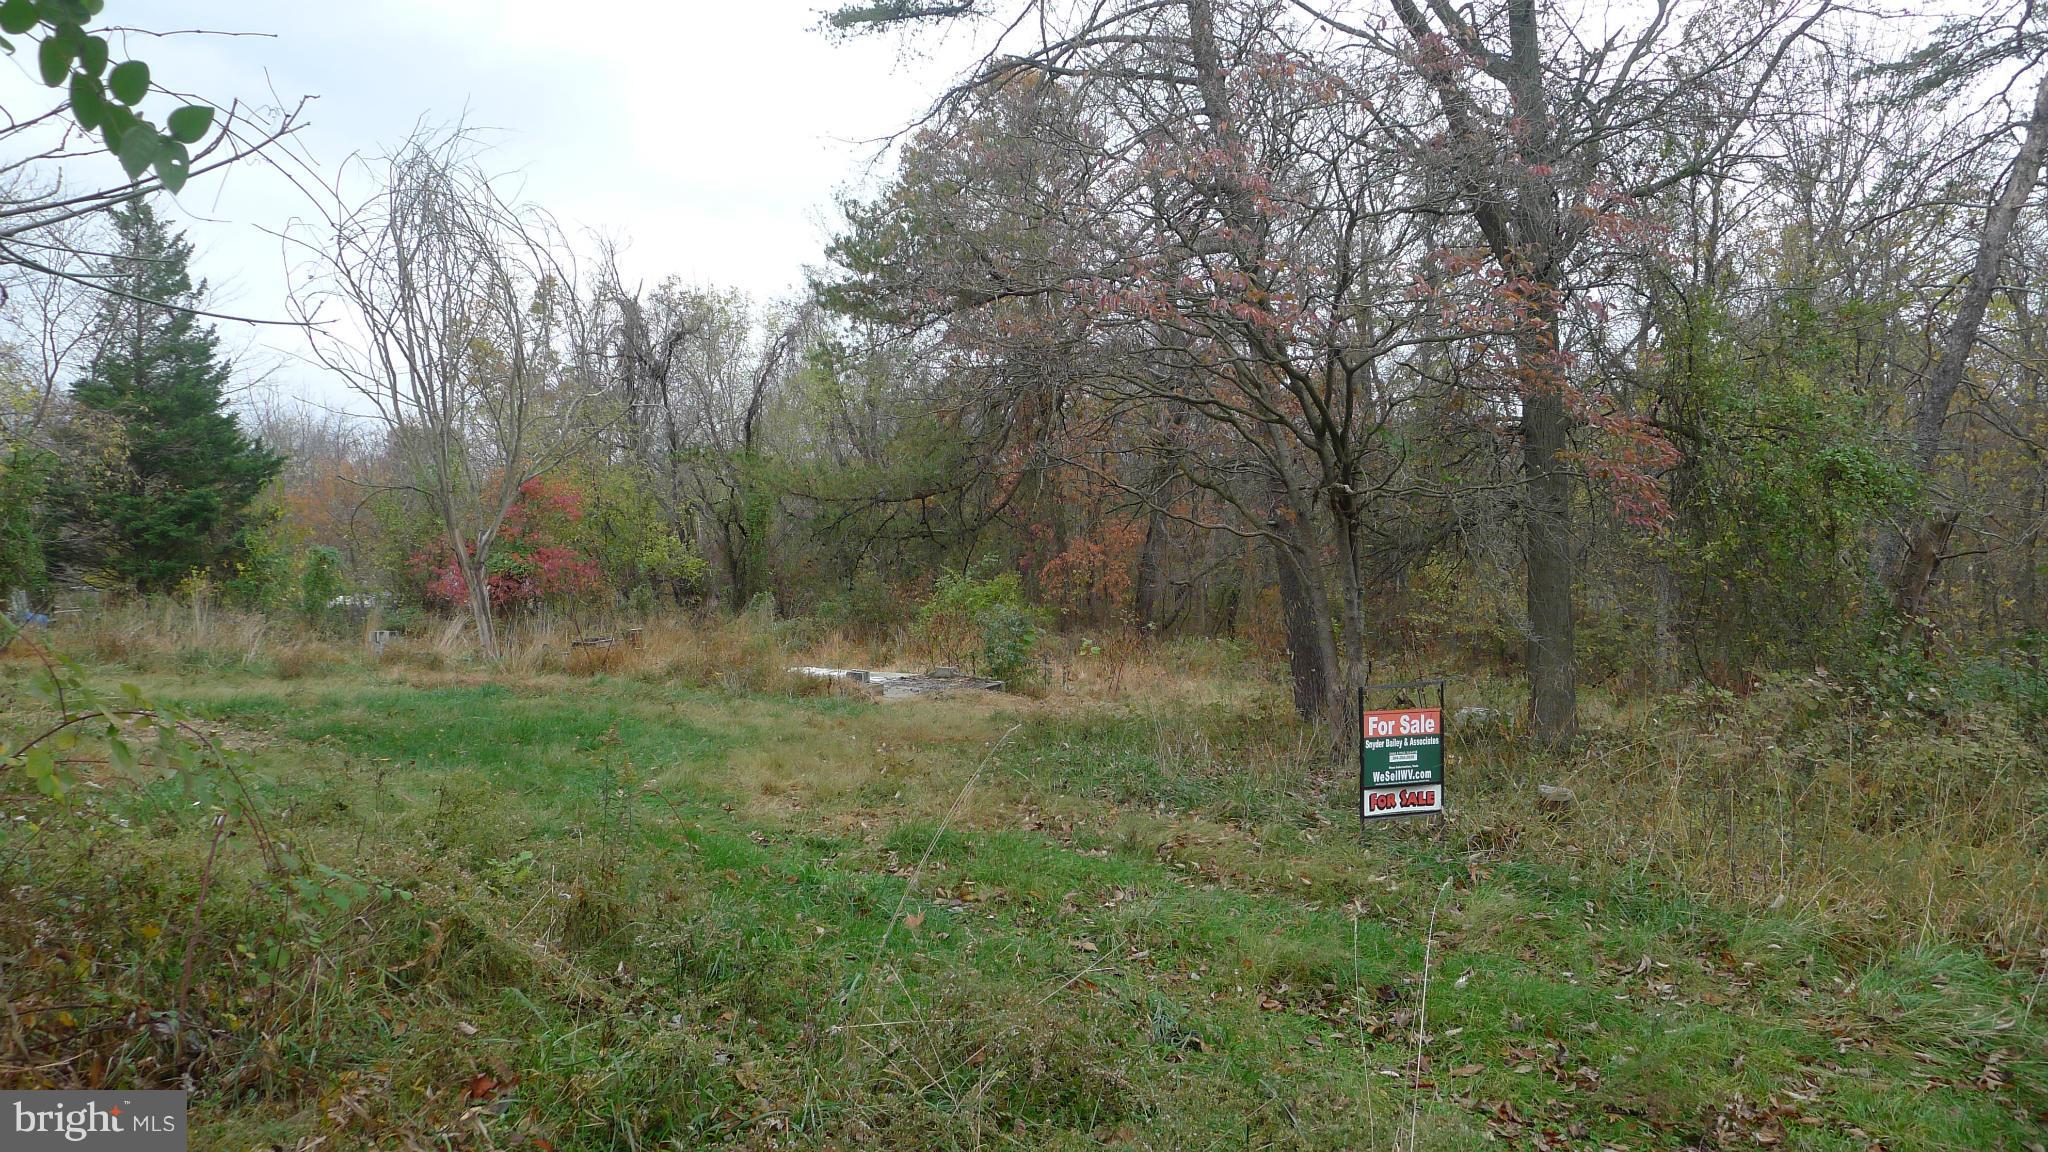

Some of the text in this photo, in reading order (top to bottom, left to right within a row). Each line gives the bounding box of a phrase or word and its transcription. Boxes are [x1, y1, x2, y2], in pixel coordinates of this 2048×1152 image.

[1368, 714, 1435, 736] For Sale
[1365, 736, 1439, 750] Snyder Bailey & Associates
[1373, 769, 1432, 783] WeSellWV.com
[1369, 788, 1435, 812] FOR SALE
